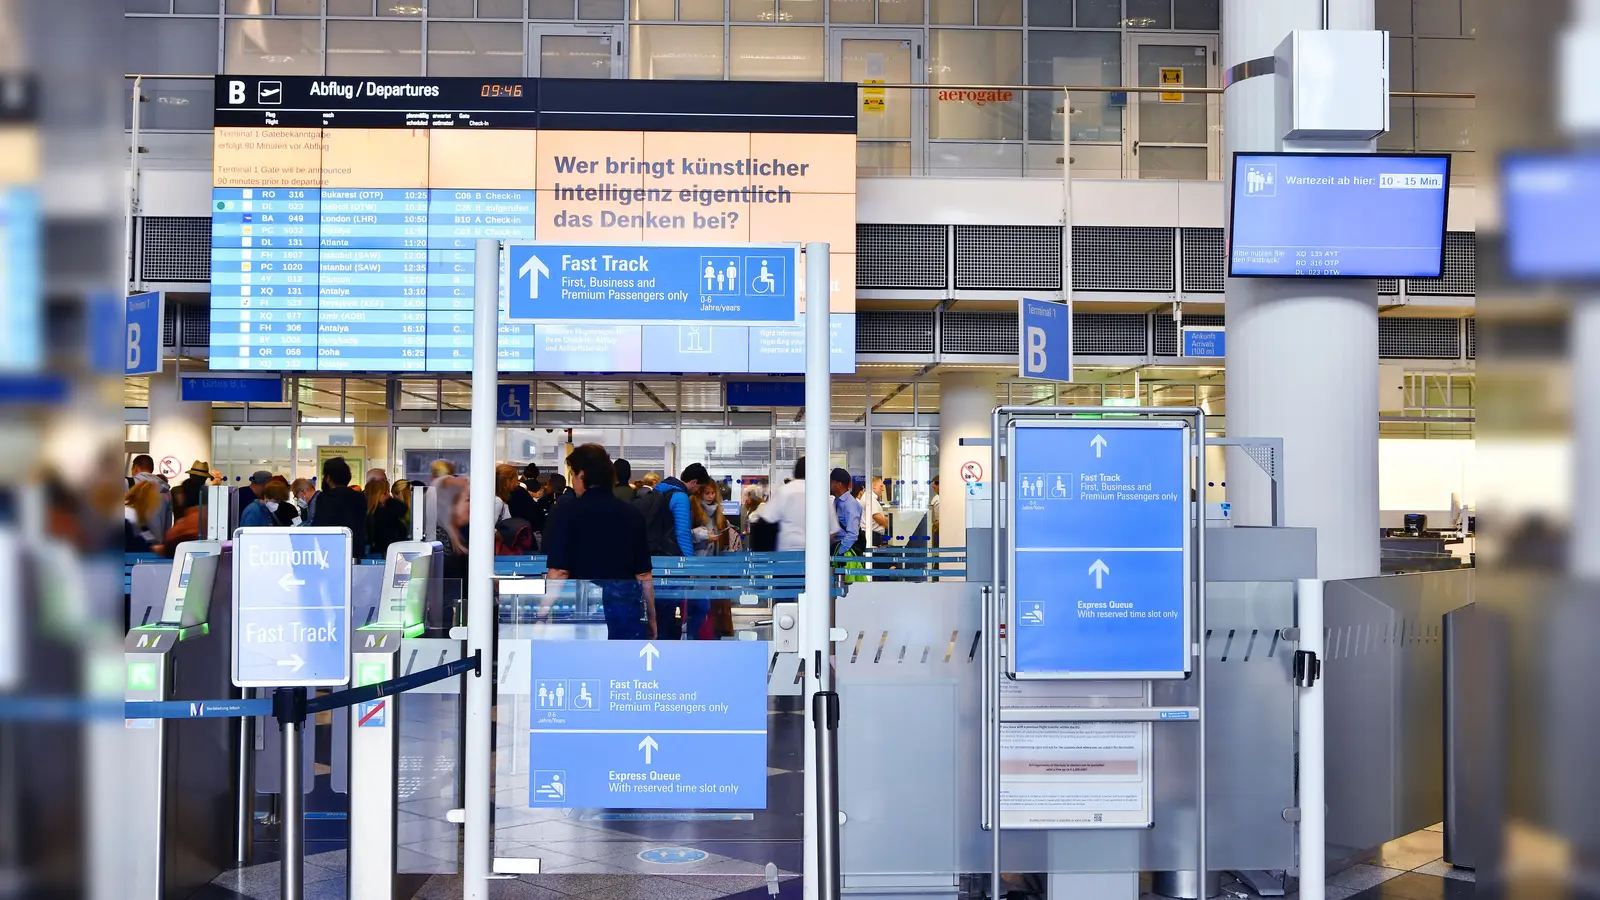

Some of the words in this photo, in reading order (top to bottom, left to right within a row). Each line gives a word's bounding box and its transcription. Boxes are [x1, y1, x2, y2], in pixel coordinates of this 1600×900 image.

[229, 81, 246, 104] B
[310, 81, 353, 99] Abflug
[367, 82, 439, 99] Departures
[481, 85, 522, 97] 09:46
[938, 88, 1013, 106] aerogate
[554, 156, 599, 174] Wer
[606, 156, 675, 179] bringt
[682, 157, 809, 177] künstlicher
[1285, 175, 1335, 185] Wartezeit
[1337, 175, 1350, 185] ab
[1353, 175, 1376, 185] hier:
[1381, 177, 1393, 185] 10
[1405, 177, 1417, 186] 15
[1420, 177, 1441, 186] Min.
[321, 190, 357, 198] Bukarest
[359, 190, 384, 200] (OTP)
[404, 191, 428, 199] 10:25
[485, 191, 521, 200] Check-in
[554, 182, 673, 206] Intelligenz
[679, 184, 791, 206] eigentlich
[321, 215, 351, 223] London
[353, 214, 377, 223] (LHR)
[475, 216, 481, 224] A
[553, 210, 593, 228] das
[600, 210, 685, 229] Denken
[693, 211, 739, 229] bei?
[403, 239, 427, 247] 11:20
[260, 263, 273, 271] PC
[282, 263, 303, 271] 1020
[320, 263, 352, 271] Istanbul
[354, 263, 381, 272] (SAW)
[403, 264, 426, 272] 12:35
[561, 254, 596, 272] Fast
[602, 254, 649, 272] Track
[562, 276, 586, 289] First,
[590, 276, 634, 288] Business
[637, 277, 656, 289] and
[260, 287, 273, 296] XQ
[287, 287, 302, 295] 131
[319, 287, 350, 297] Antalya
[403, 288, 426, 296] 13:10
[561, 290, 606, 301] Premium
[608, 290, 665, 303] Passengers
[667, 290, 689, 303] only
[700, 296, 712, 304] 0-6
[700, 304, 741, 313] Jahre/years
[1028, 303, 1052, 317] Terminal
[318, 324, 349, 333] Antalya
[126, 322, 141, 370] B
[1027, 326, 1047, 373] B
[1191, 340, 1215, 348] Arrivals
[259, 348, 273, 356] QR
[318, 348, 340, 356] Doha
[402, 349, 425, 357] 16:25
[1080, 473, 1097, 482] Fast
[1099, 473, 1121, 482] Track
[1080, 482, 1099, 492] First,
[1101, 482, 1135, 491] Business
[1137, 482, 1152, 491] and
[1080, 492, 1116, 500] Premium
[1117, 492, 1160, 501] Passengers
[1161, 492, 1178, 502] only
[249, 545, 329, 570] Economy
[1077, 600, 1107, 610] Express
[1109, 600, 1134, 609] Queue
[1077, 610, 1097, 618] With
[1098, 610, 1128, 618] reserved
[1130, 610, 1147, 618] time
[1148, 610, 1162, 618] slot
[1162, 610, 1178, 619] only
[246, 625, 285, 643] Fast
[291, 624, 338, 642] Track
[609, 680, 630, 689] Fast
[633, 680, 659, 689] Track
[609, 691, 632, 701] First,
[635, 691, 676, 701] Business
[680, 691, 697, 701] and
[609, 702, 651, 712] Premium
[654, 702, 706, 714] Passengers
[709, 702, 729, 714] only
[609, 771, 647, 782] Express
[649, 771, 681, 781] Queue
[609, 783, 631, 793] With
[633, 783, 673, 793] reserved
[676, 783, 697, 793] time
[699, 783, 717, 793] slot
[719, 783, 739, 794] only
